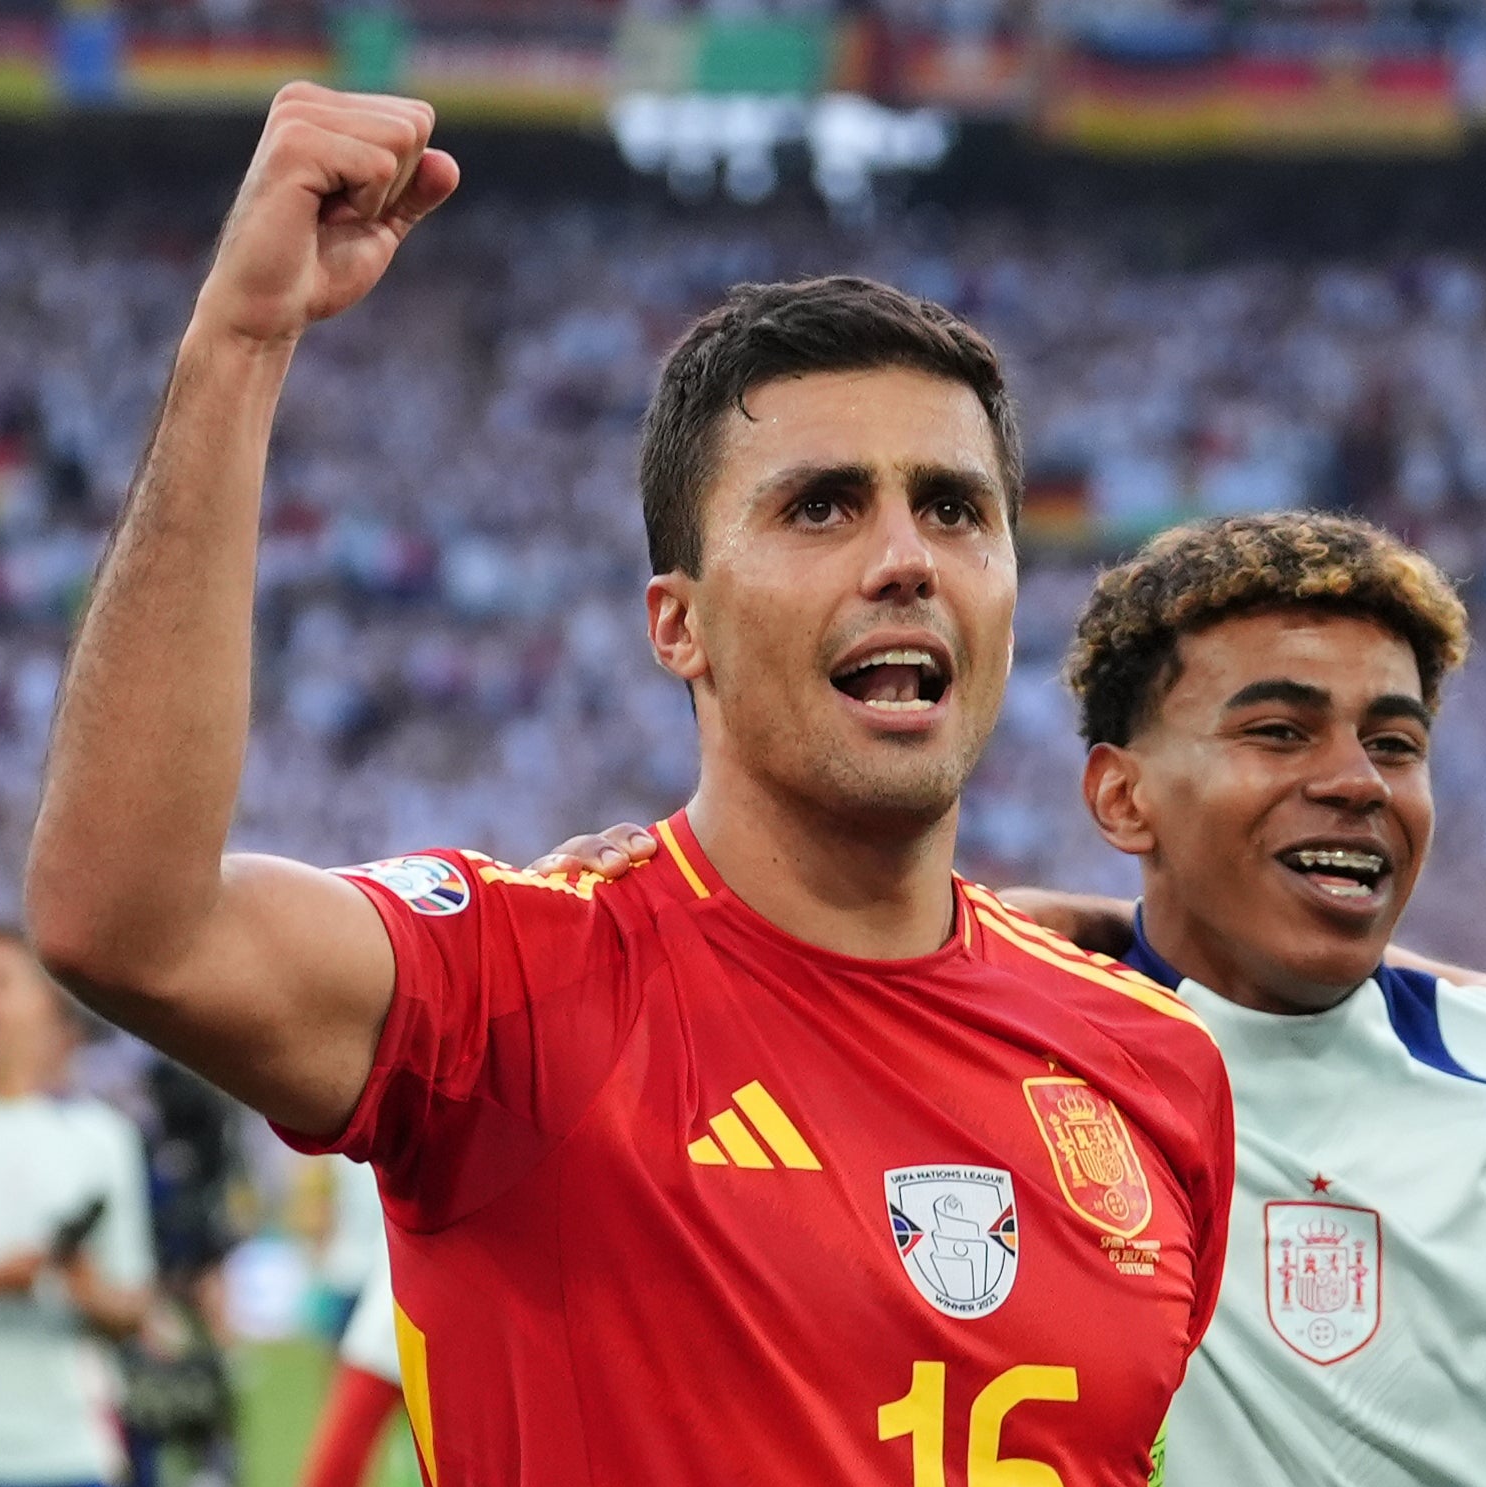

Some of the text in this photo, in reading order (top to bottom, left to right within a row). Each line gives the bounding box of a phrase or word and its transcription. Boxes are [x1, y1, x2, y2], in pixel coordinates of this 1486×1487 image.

[890, 1170, 1005, 1185] UEFA NATIONS LEAGUE
[935, 1293, 975, 1312] WINNER
